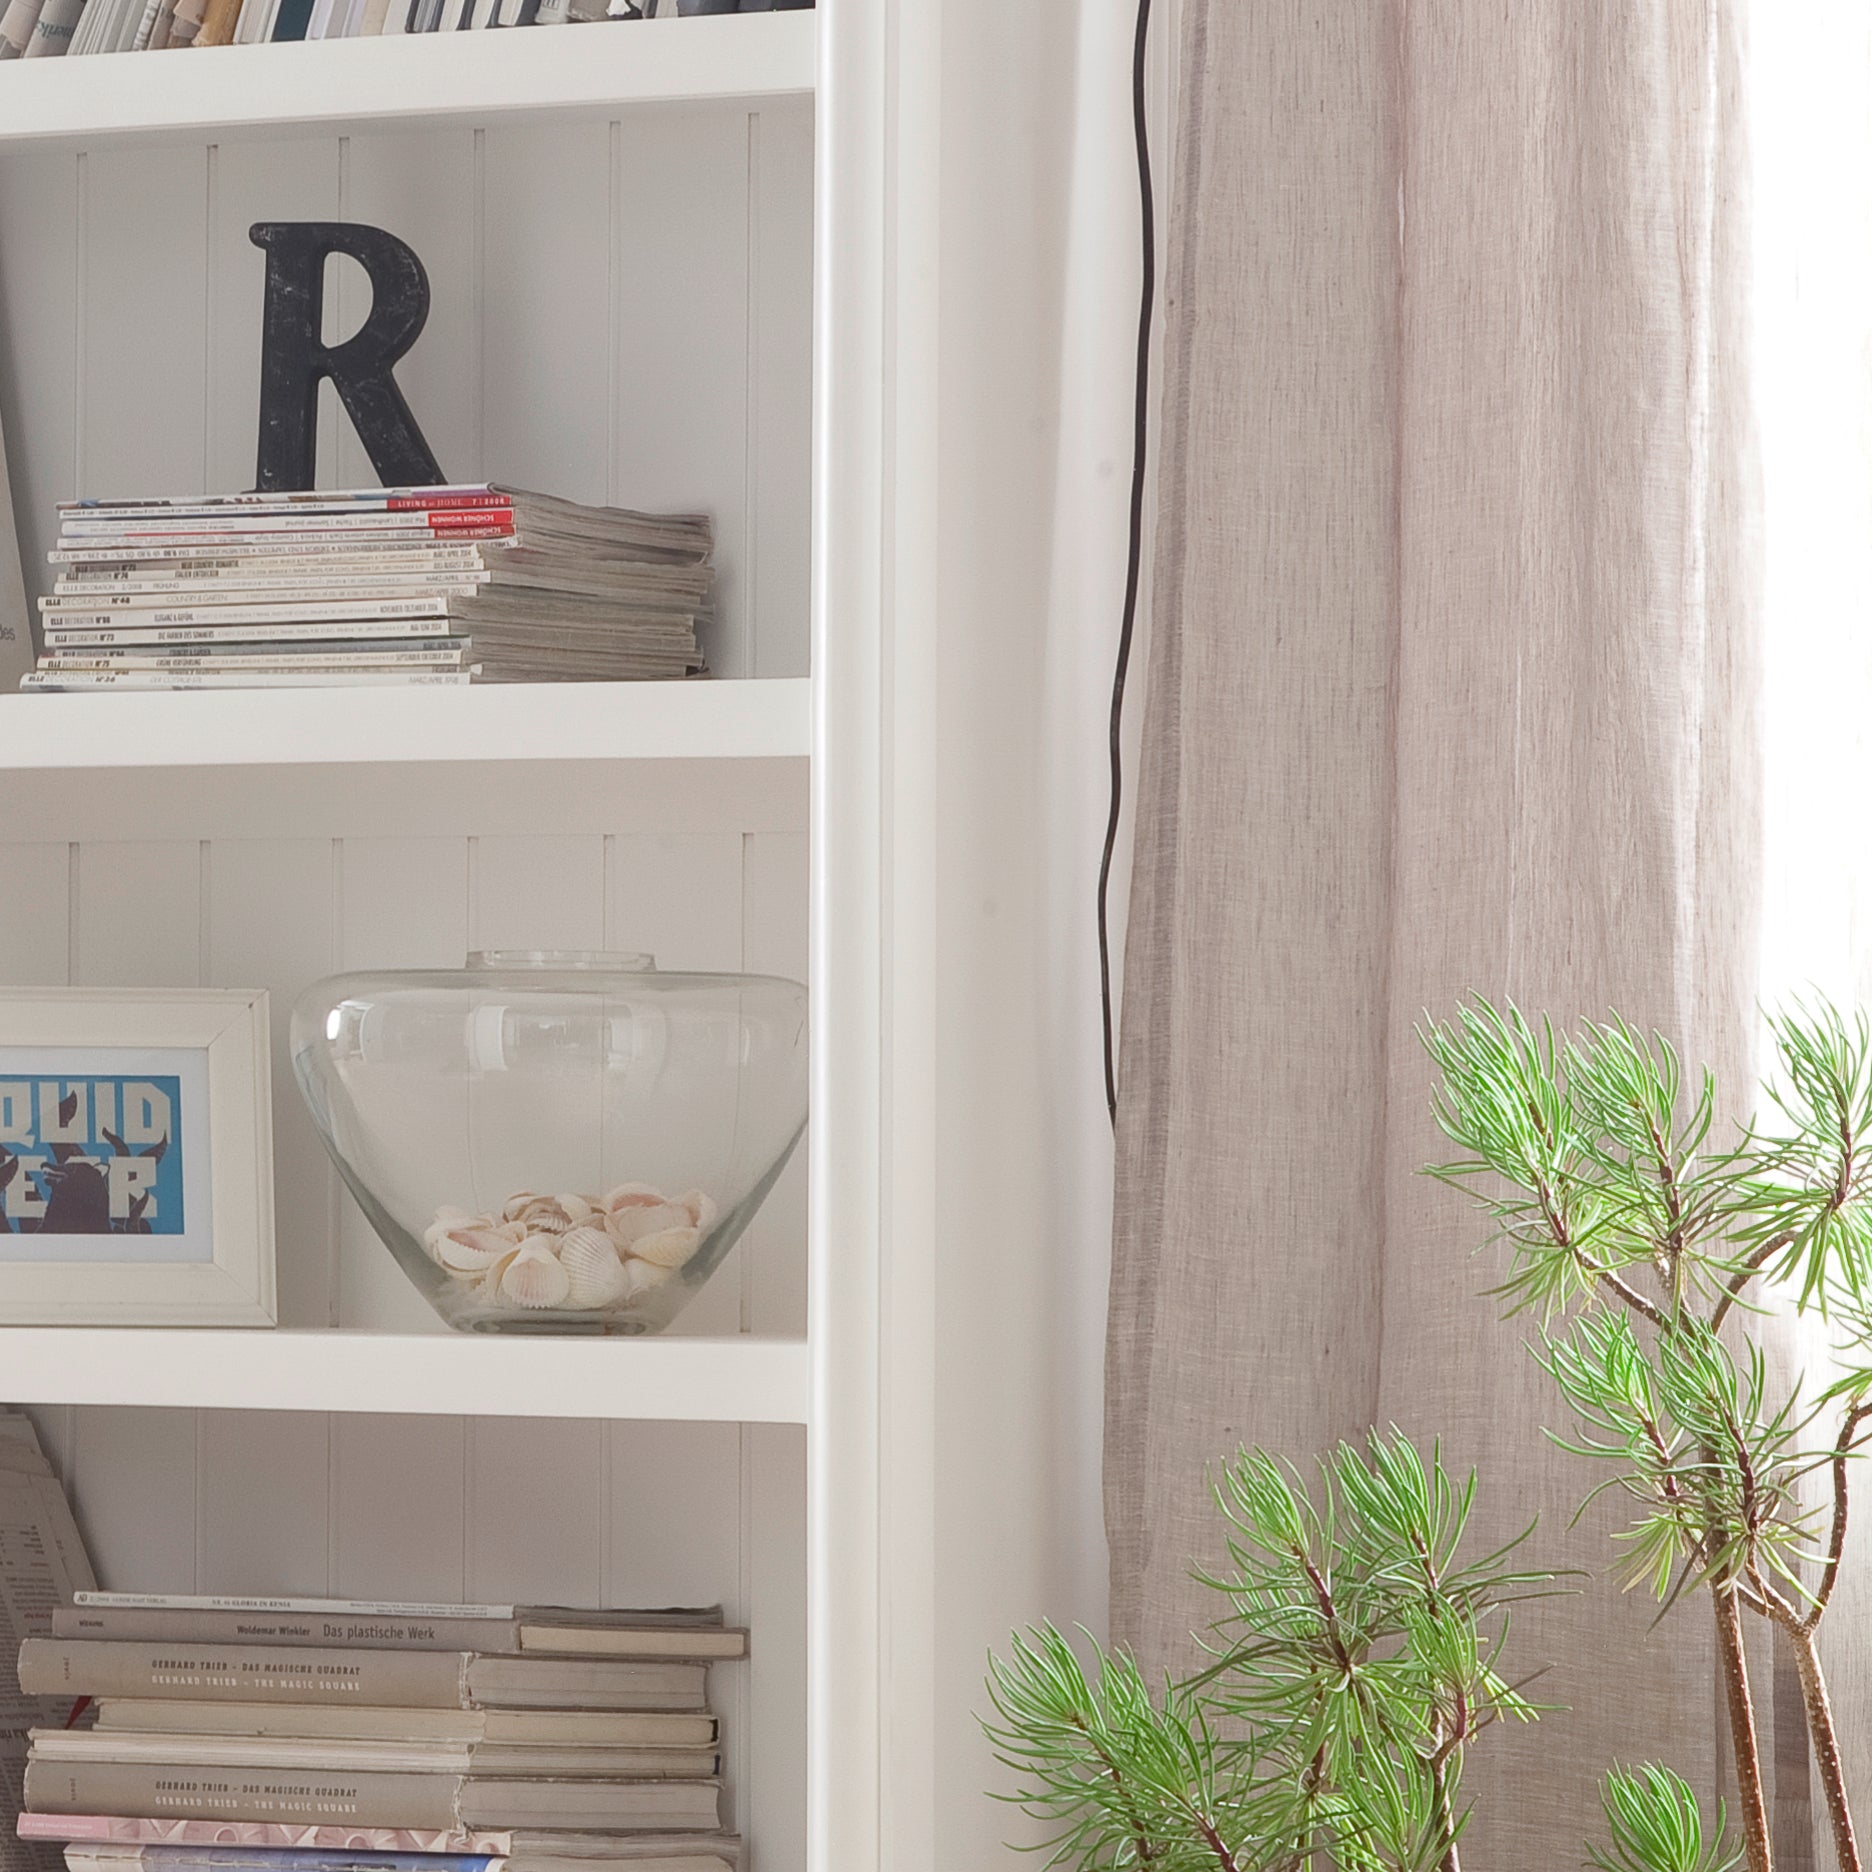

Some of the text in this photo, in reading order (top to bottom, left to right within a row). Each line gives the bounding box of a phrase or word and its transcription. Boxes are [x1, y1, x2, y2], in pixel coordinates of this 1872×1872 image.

[249, 222, 448, 491] R
[397, 499, 427, 509] LIVING
[437, 498, 463, 508] HOME
[431, 514, 495, 524] SCHÖNER WOHNEN
[437, 526, 501, 537] SCHÖNER WOHNEN
[237, 1625, 311, 1637] Woldemar Winkler
[323, 1624, 435, 1640] Das plastische Werk
[152, 1659, 361, 1676] GERHARD TRIEB DAS MAGISCHE QUADRAT
[151, 1675, 361, 1691] GERHARD TRIEB THE MAGIC SQUARE
[155, 1780, 357, 1798] GERHARD TRIEB DAS MAGISCHE QUADRAT
[155, 1795, 357, 1813] GERHARD TRIEB THE MAGIC SQUARE
